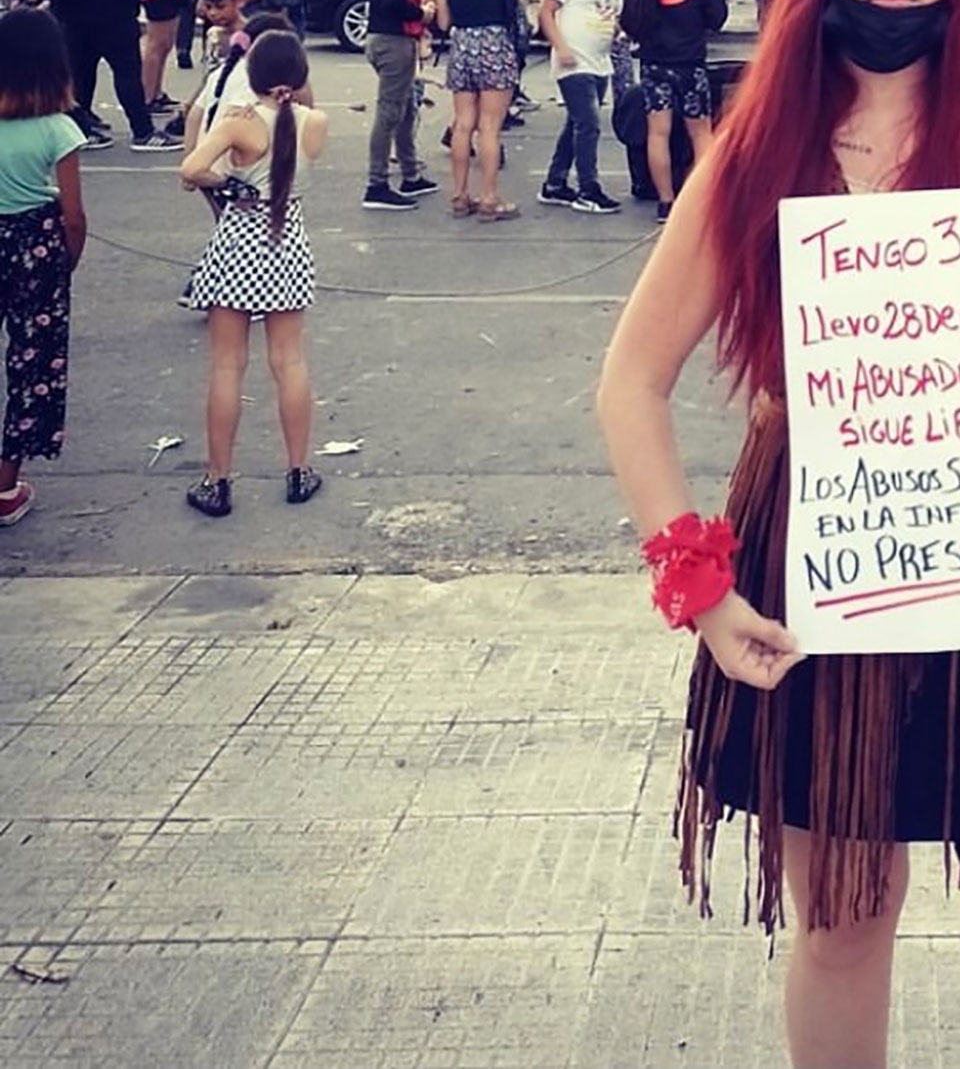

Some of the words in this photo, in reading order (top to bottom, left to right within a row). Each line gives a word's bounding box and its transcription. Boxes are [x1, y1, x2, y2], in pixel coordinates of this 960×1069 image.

[801, 218, 927, 280] TENGO
[882, 301, 923, 339] 28
[800, 466, 846, 503] LOS
[848, 456, 942, 504] ABUSOS
[817, 514, 855, 538] EN
[863, 506, 896, 531] LA
[804, 548, 860, 592] NO
